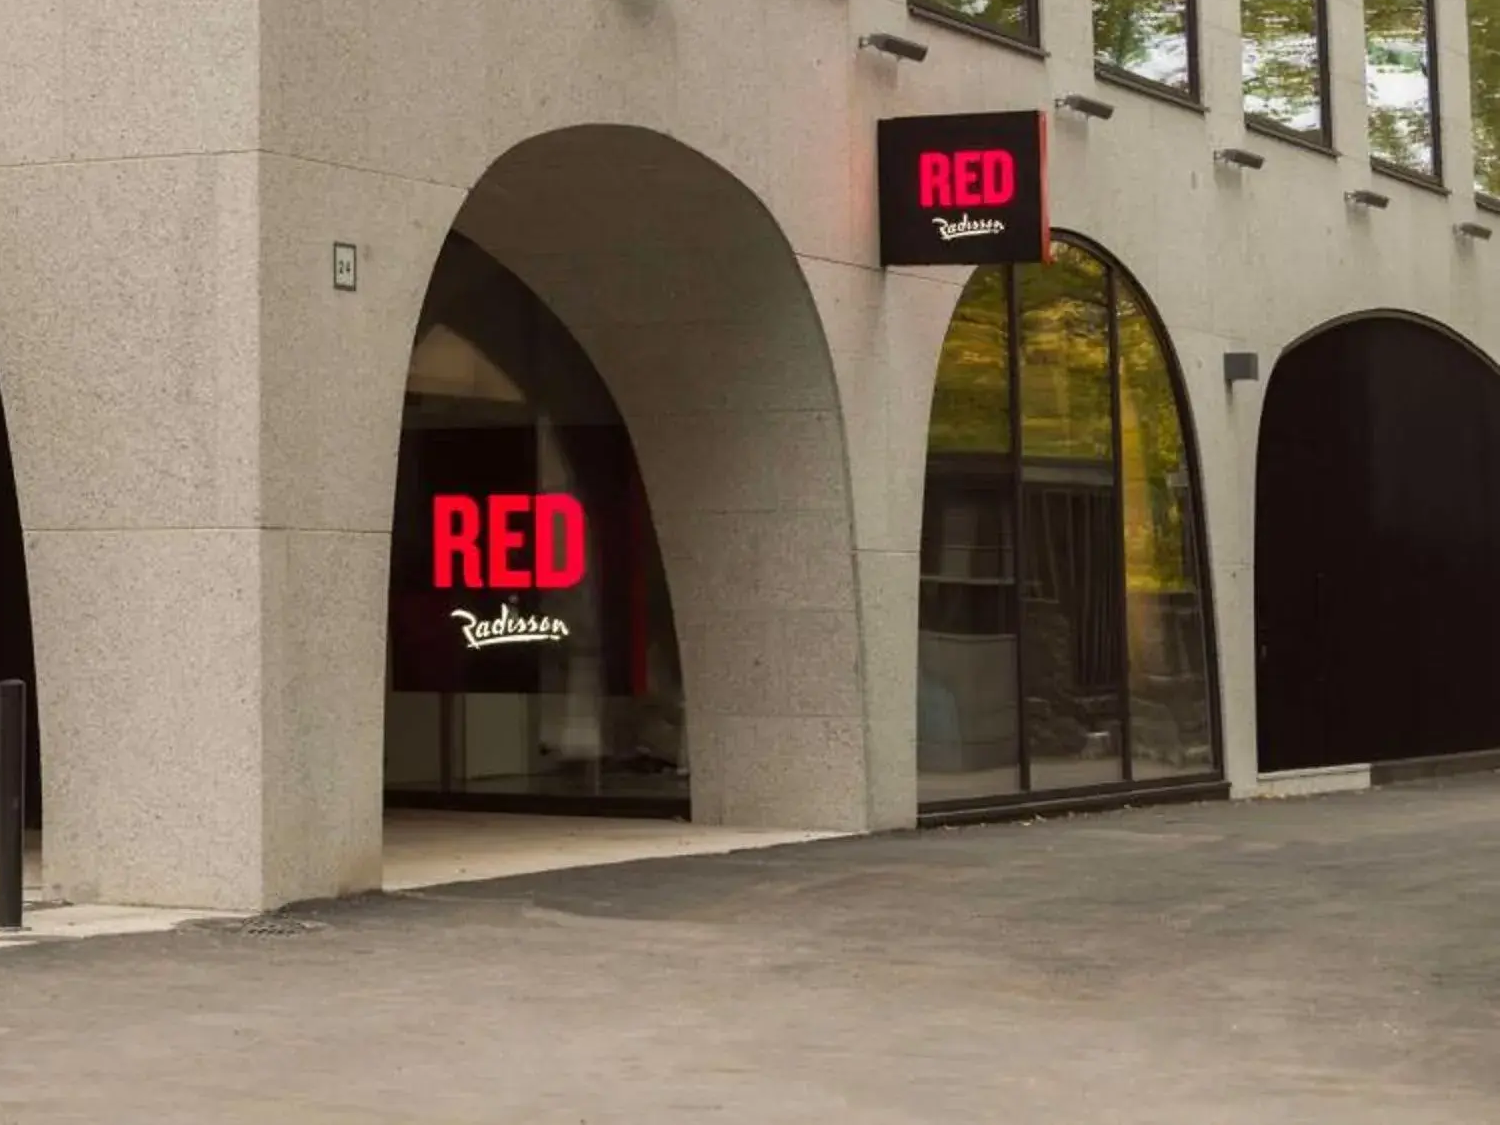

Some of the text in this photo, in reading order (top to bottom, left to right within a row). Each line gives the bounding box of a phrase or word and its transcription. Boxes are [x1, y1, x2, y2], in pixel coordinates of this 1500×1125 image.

[918, 148, 1015, 208] RED
[932, 213, 1005, 241] Radisson
[432, 492, 587, 589] RED
[451, 603, 570, 649] Radisson
